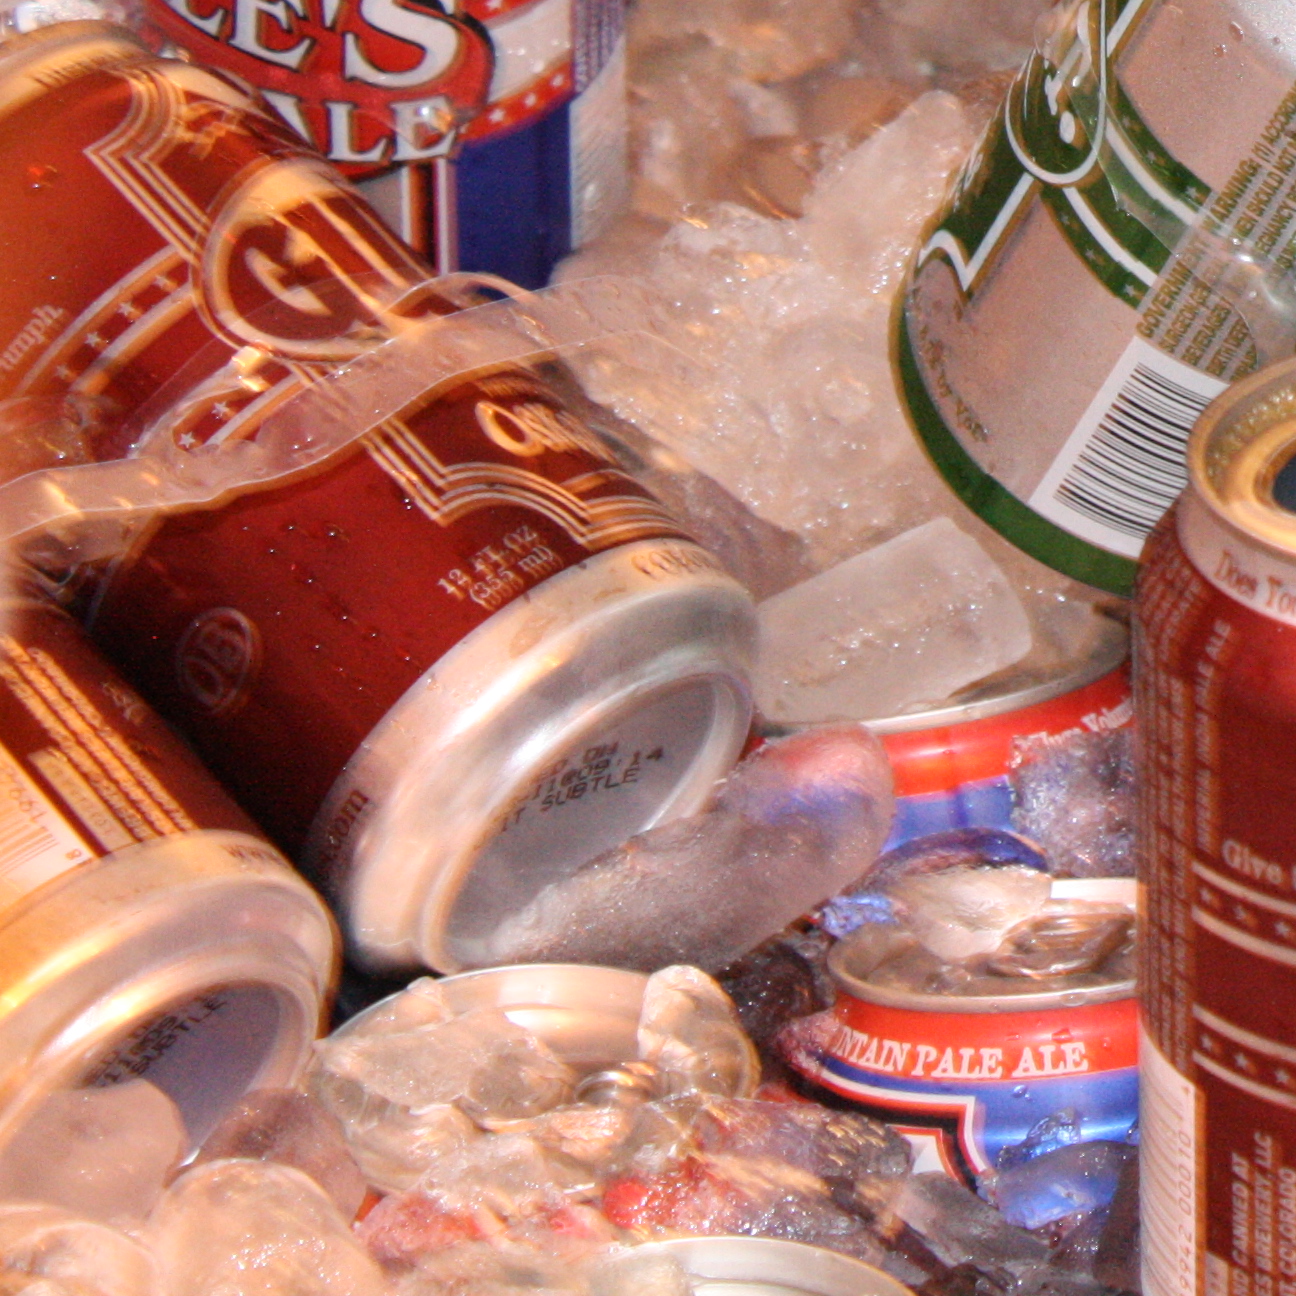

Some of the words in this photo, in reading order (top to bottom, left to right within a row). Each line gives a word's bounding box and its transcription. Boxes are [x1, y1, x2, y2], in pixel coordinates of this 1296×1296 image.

[0, 302, 63, 372] umph.
[438, 568, 468, 598] 12
[1215, 551, 1258, 595] Does
[540, 767, 640, 812] SUBTLE
[1222, 840, 1282, 884] Give
[836, 1027, 913, 1075] NTAIN
[911, 1045, 1003, 1078] PALE
[1012, 1042, 1089, 1077] ALE
[1230, 1151, 1250, 1180] AT
[1252, 1131, 1273, 1168] LLC
[1227, 1180, 1252, 1265] CANNED
[1248, 1171, 1278, 1271] BREWERY,
